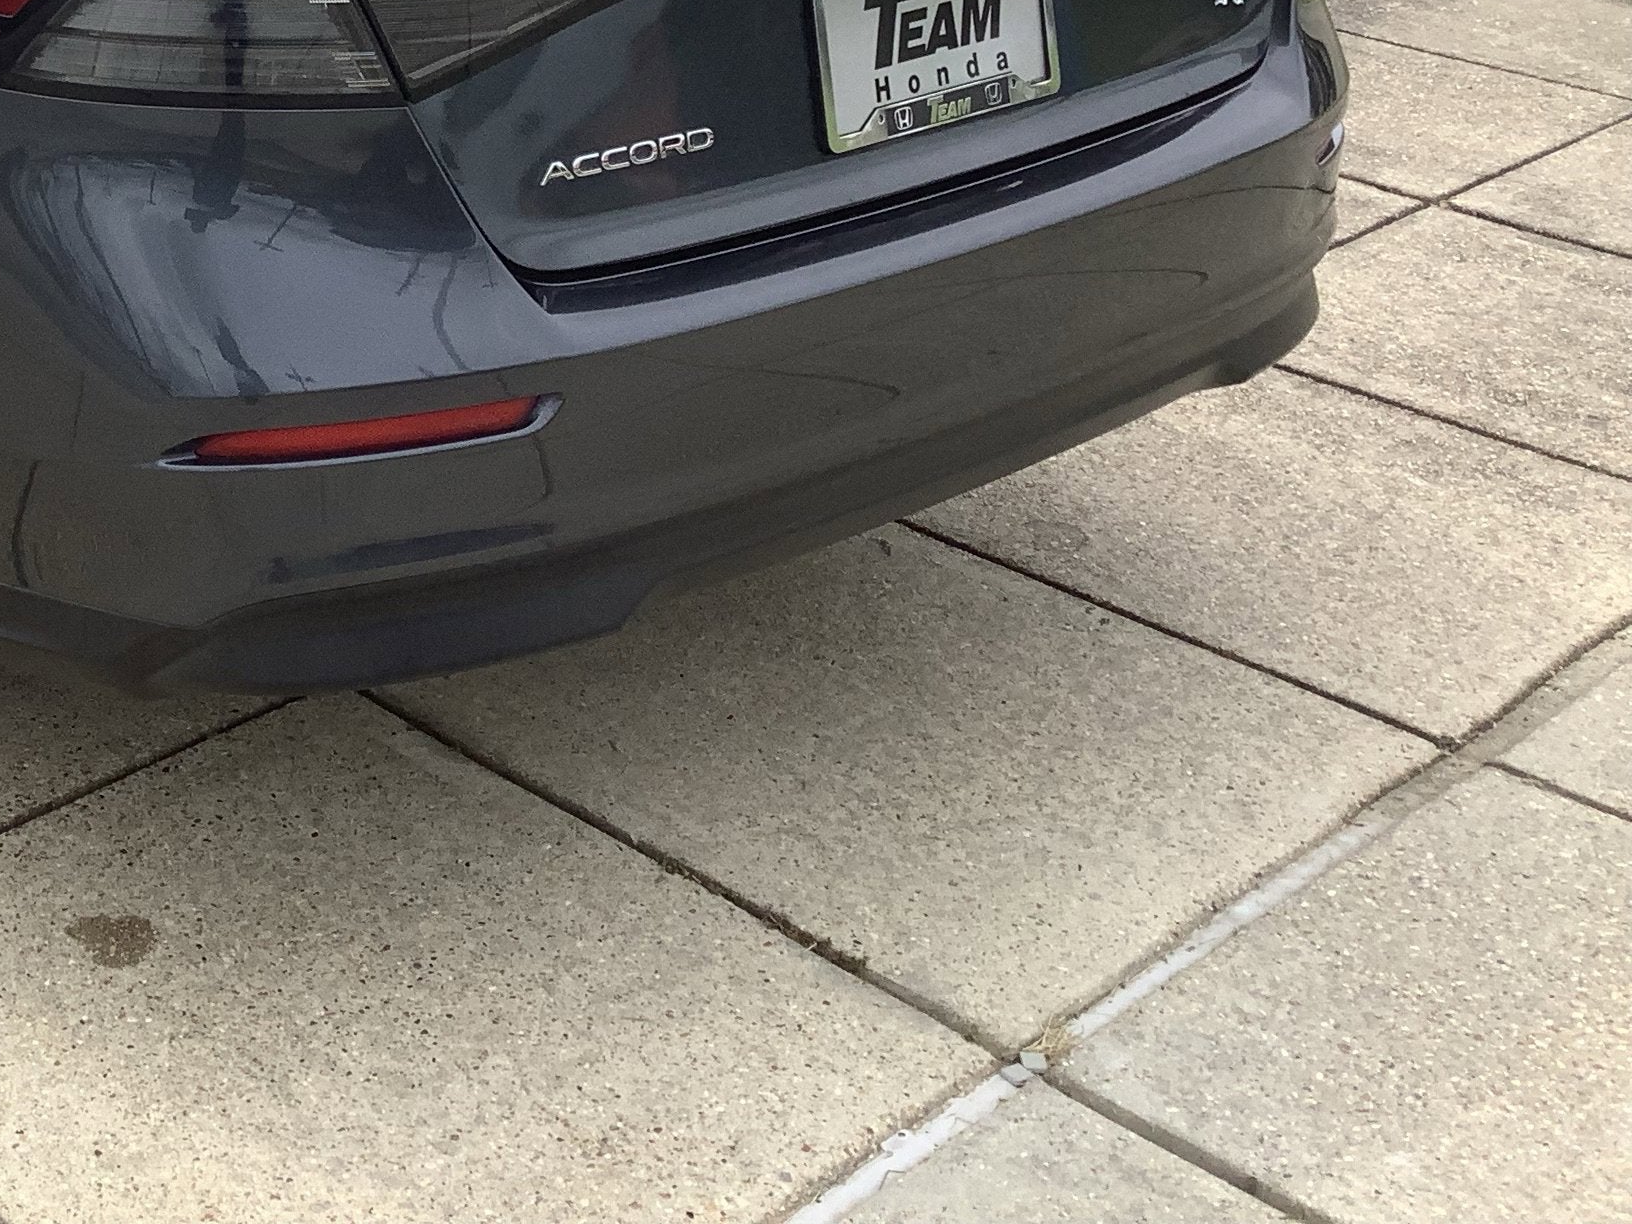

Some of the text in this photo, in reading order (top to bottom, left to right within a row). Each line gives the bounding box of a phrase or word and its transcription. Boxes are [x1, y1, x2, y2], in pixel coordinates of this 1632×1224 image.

[874, 51, 1009, 103] Honda
[926, 96, 972, 124] TEAM
[539, 127, 715, 187] ACCORD
